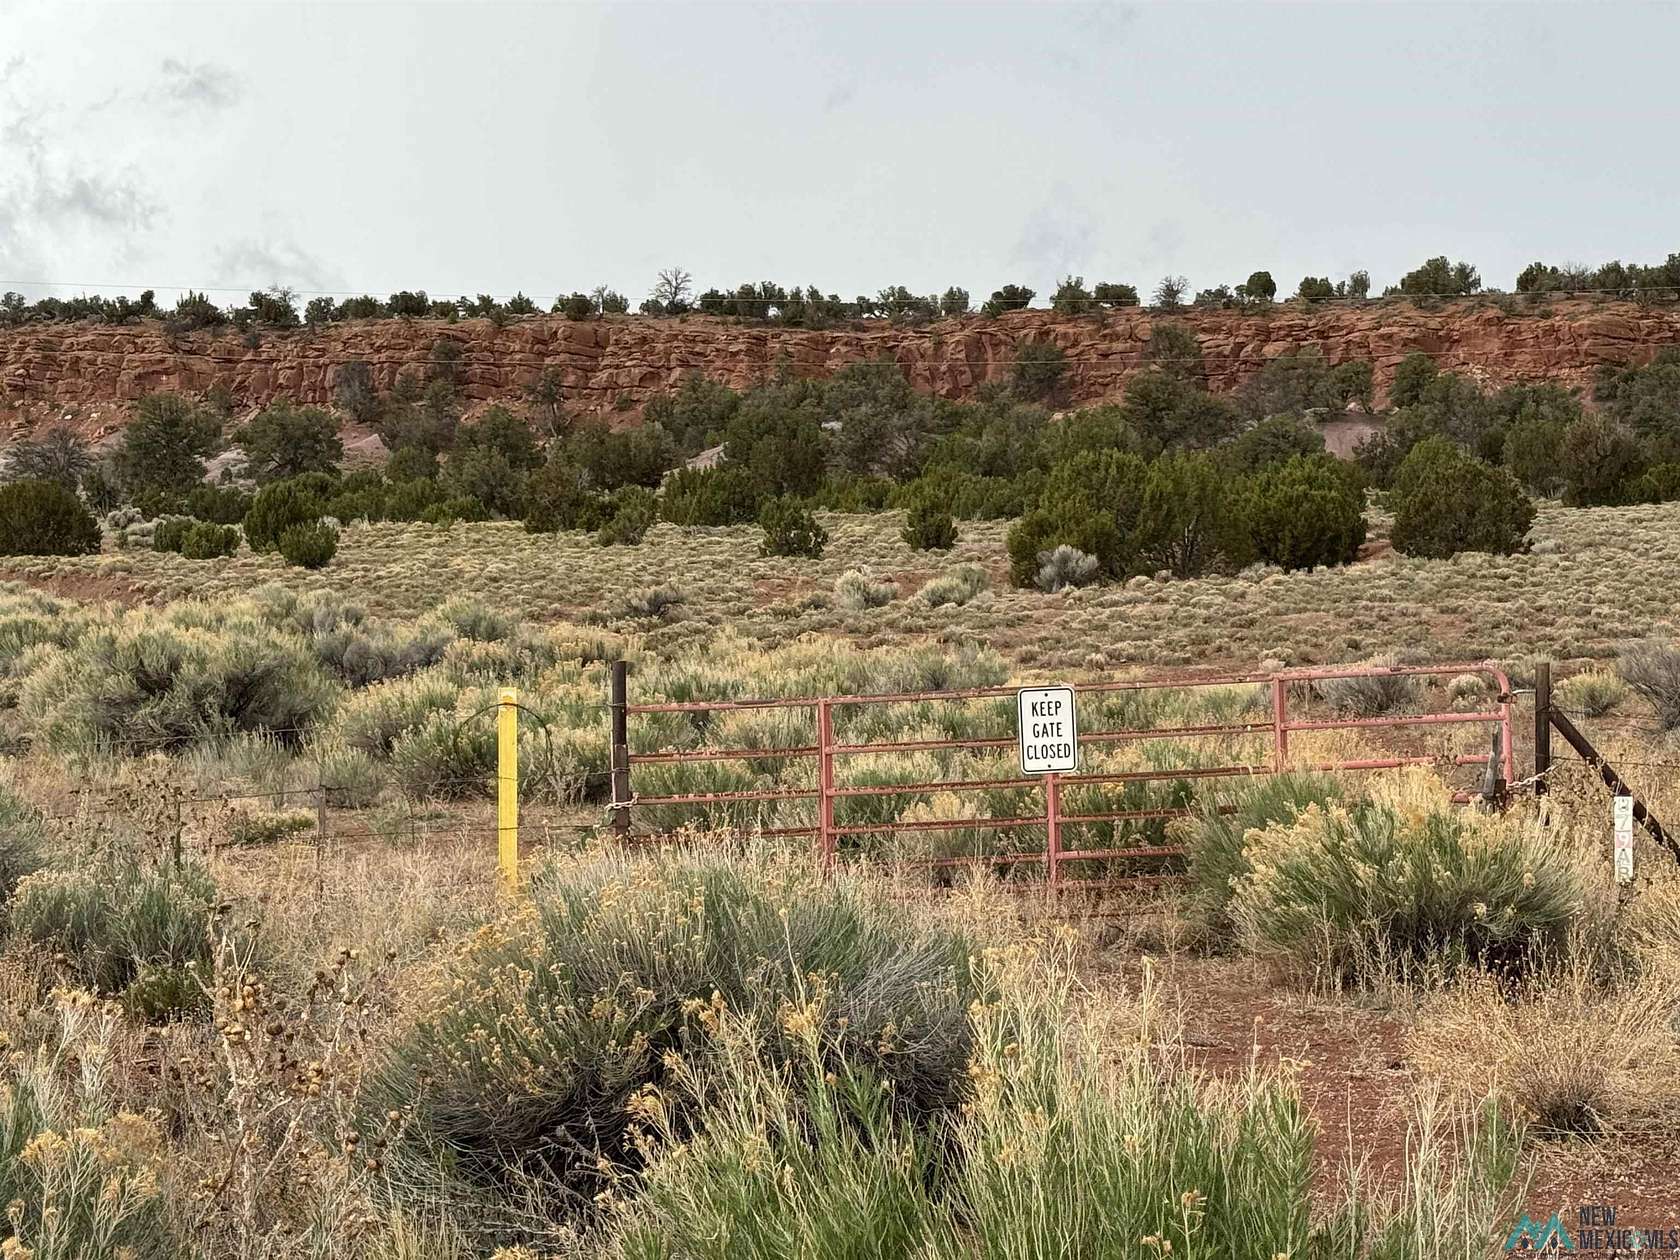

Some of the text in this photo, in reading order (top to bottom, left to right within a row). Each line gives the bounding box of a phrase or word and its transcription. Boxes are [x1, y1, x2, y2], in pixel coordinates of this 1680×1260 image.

[1031, 701, 1062, 717] KEEP
[1032, 722, 1063, 738] GATE
[1026, 743, 1071, 760] CLOSED
